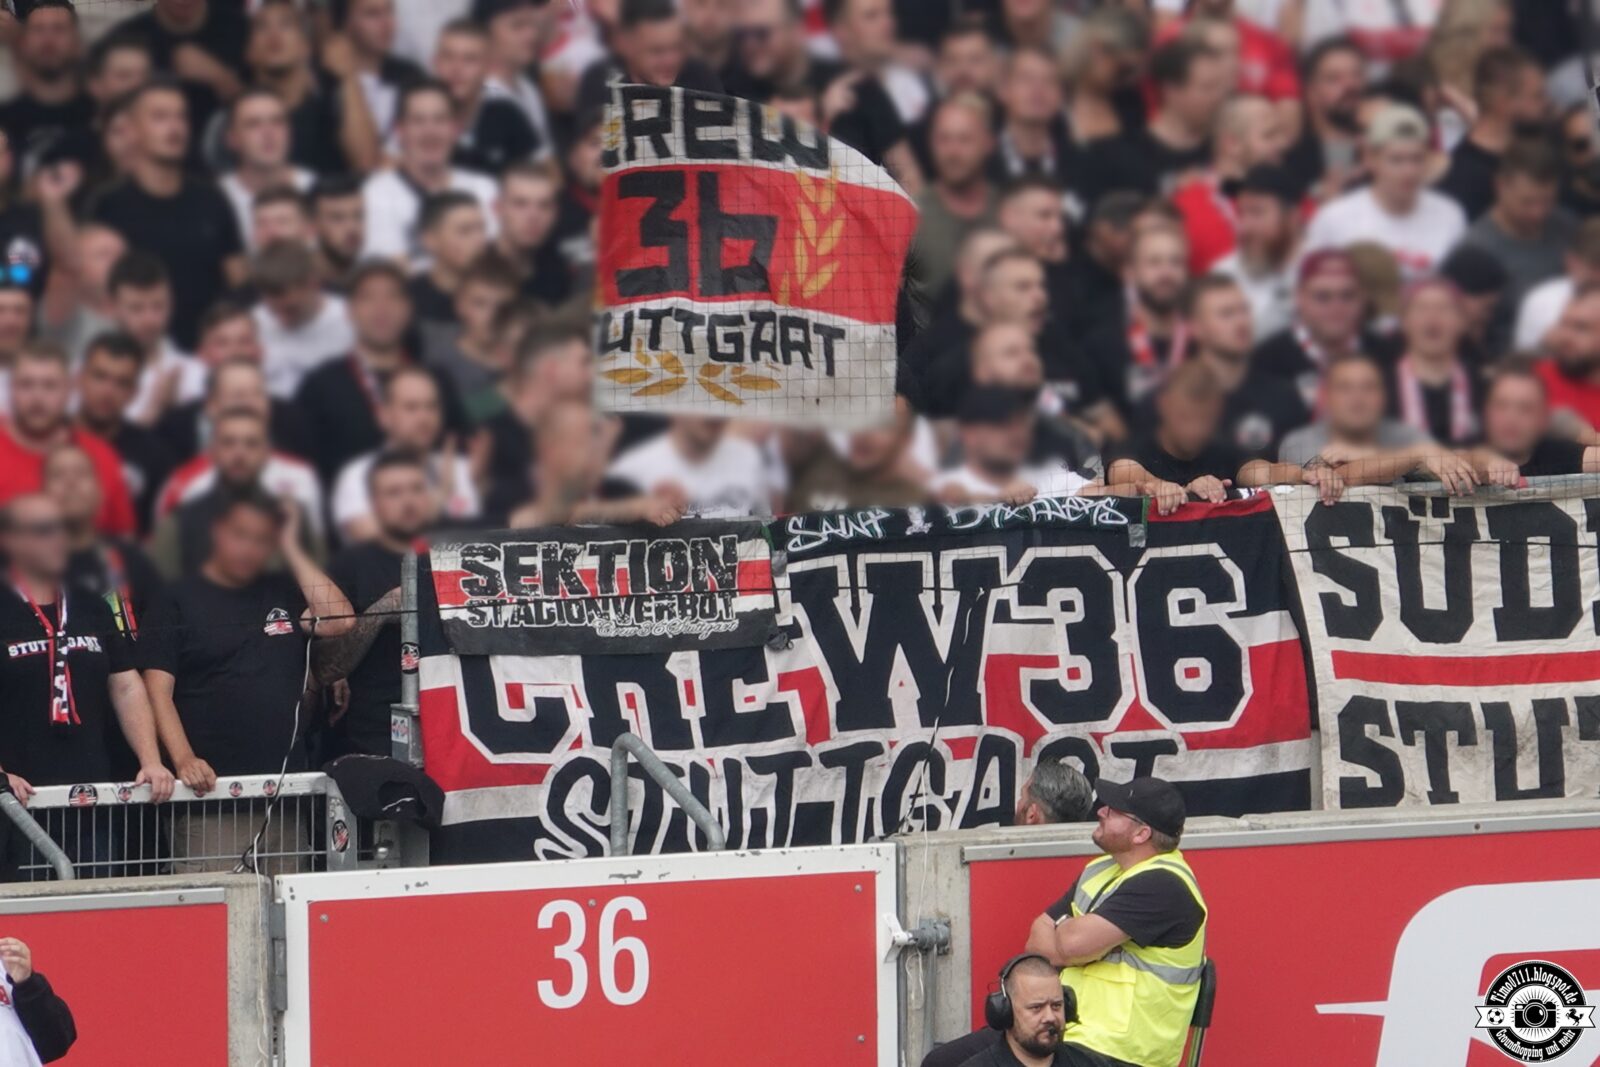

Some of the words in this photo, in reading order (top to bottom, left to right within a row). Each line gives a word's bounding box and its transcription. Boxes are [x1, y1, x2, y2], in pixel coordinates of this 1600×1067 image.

[602, 85, 830, 170] REW
[615, 169, 779, 298] 36
[459, 534, 738, 599] SEKTION
[787, 507, 890, 551] SAINT
[1304, 495, 1600, 643] SÜD
[536, 895, 650, 1009] 36
